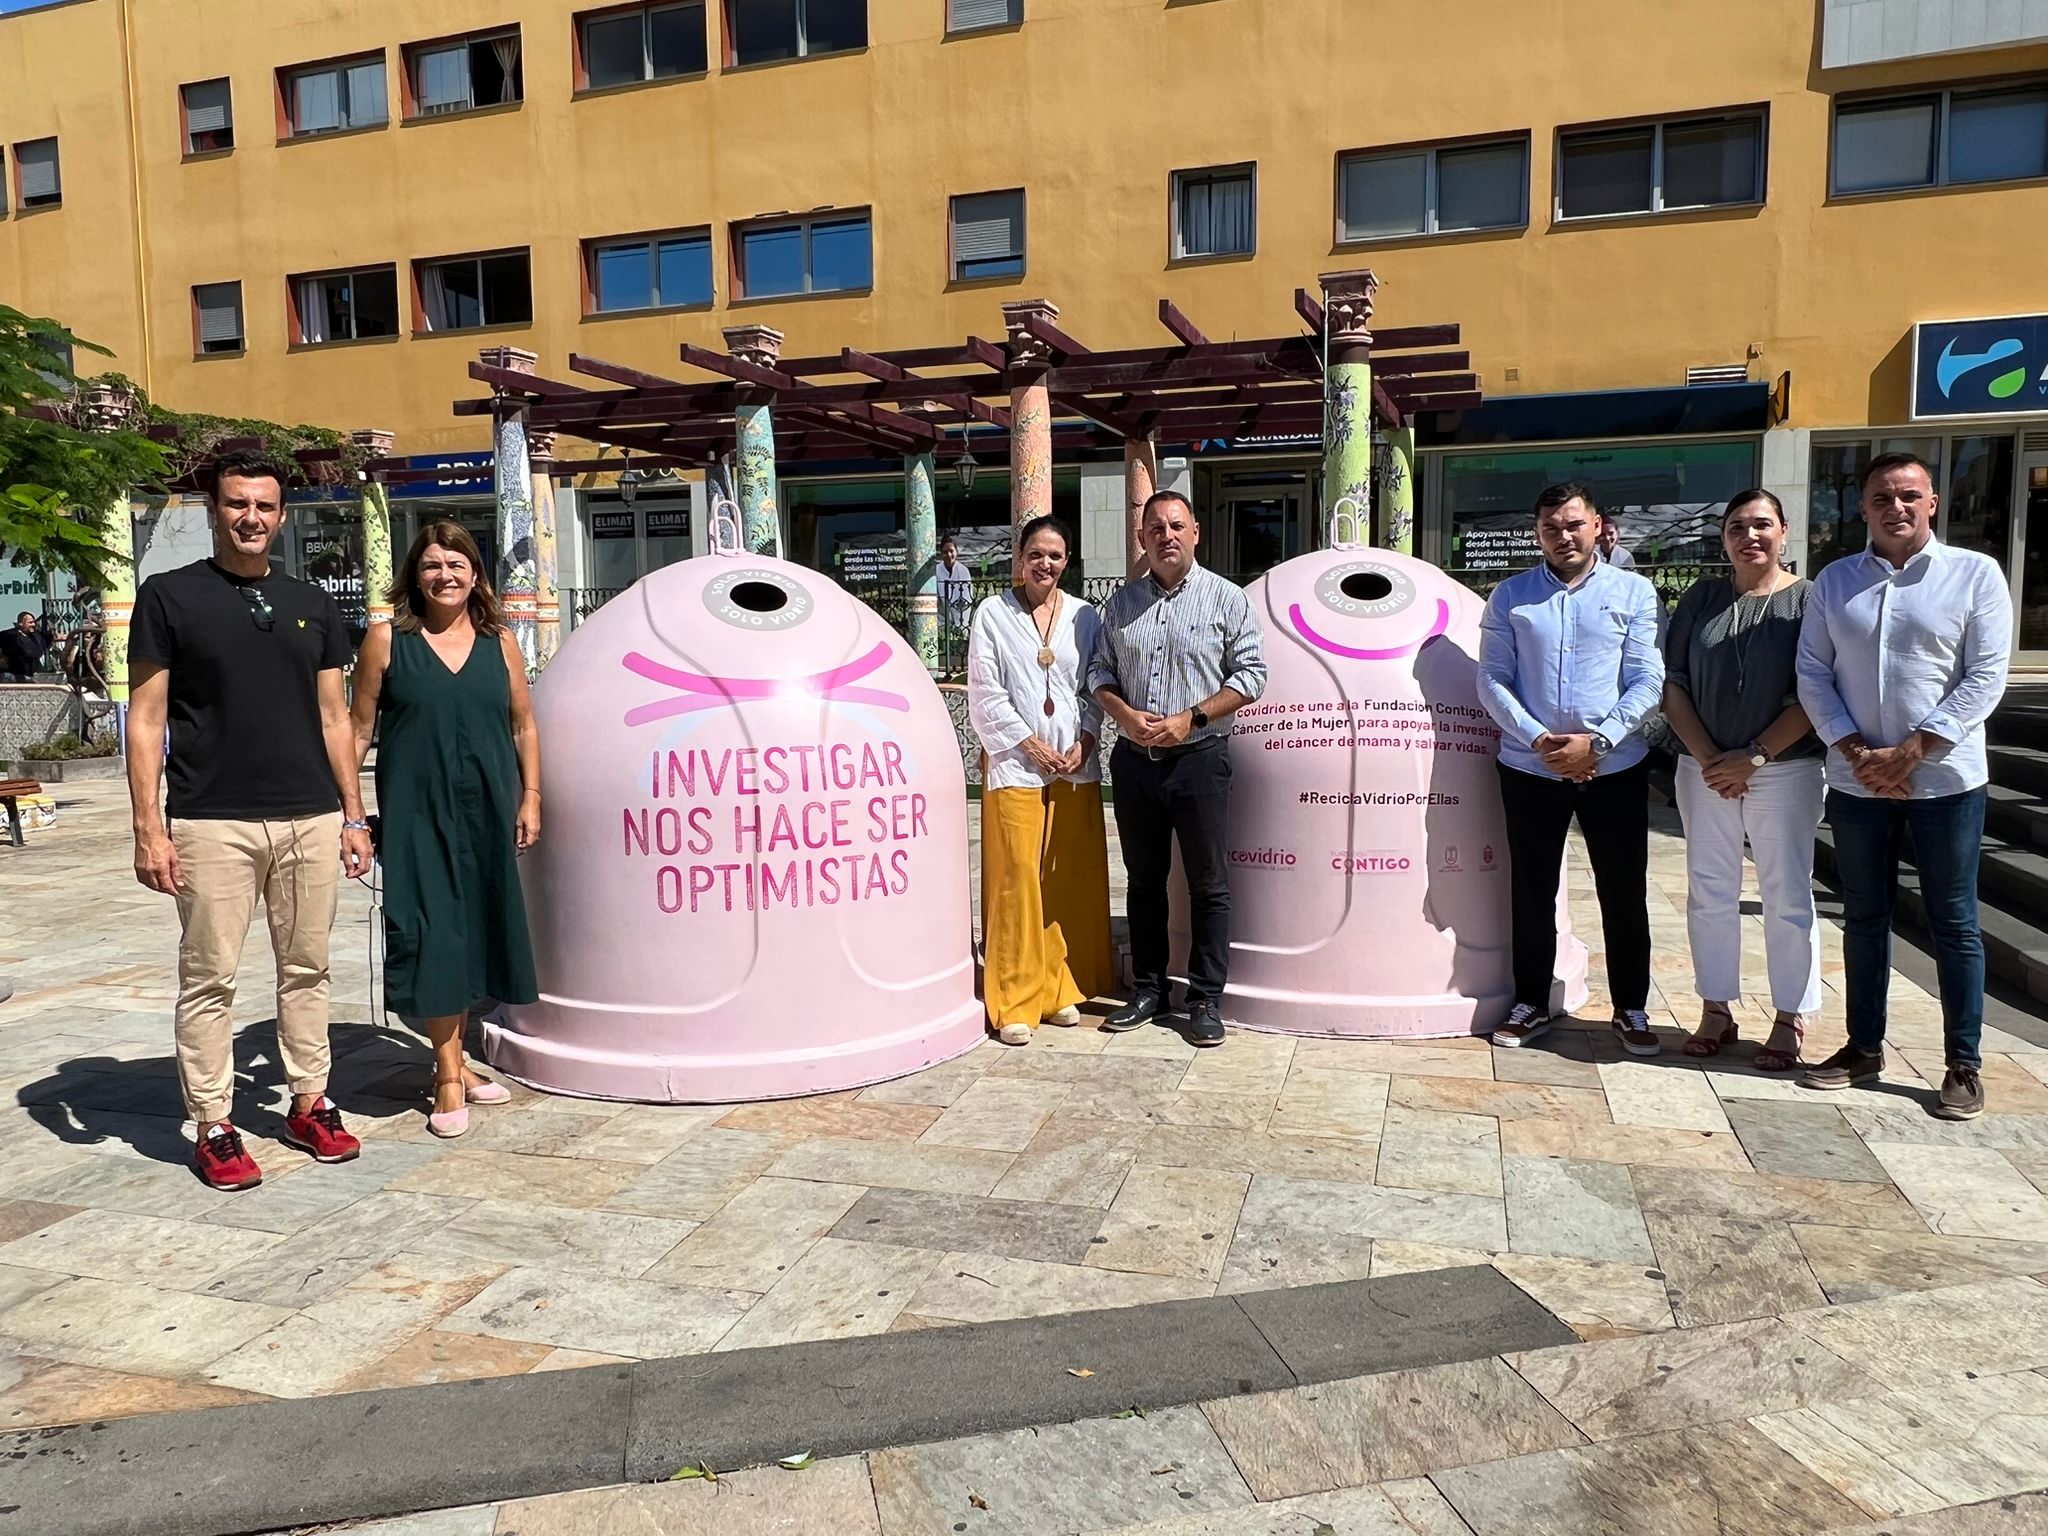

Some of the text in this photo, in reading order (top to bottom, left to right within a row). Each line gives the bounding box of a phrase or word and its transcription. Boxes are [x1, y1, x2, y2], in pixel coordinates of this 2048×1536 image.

[595, 516, 632, 527] ELIMAT
[648, 514, 688, 525] ELIMAT
[1465, 531, 1510, 539] Apoyamos
[1493, 539, 1504, 547] las
[1465, 549, 1509, 557] soluciones
[1473, 559, 1509, 568] digitales
[712, 571, 797, 594] SOLO VIDRIO
[1325, 564, 1406, 584] SOLO VIDRIO
[1324, 591, 1407, 613] SOLO VIDRIO
[720, 597, 806, 625] SOLO VIDRIO
[1236, 702, 1286, 718] covidrio
[1289, 704, 1304, 713] se
[1308, 702, 1333, 712] une
[1337, 702, 1345, 711] a
[1347, 700, 1359, 711] la
[1436, 702, 1484, 719] Contigo
[1232, 722, 1274, 736] Cáncer
[1277, 720, 1293, 731] de
[1297, 718, 1308, 730] la
[1312, 717, 1350, 731] Mujer
[1358, 719, 1389, 730] para
[1392, 720, 1435, 733] apoyar
[1440, 721, 1450, 732] la
[1265, 738, 1284, 750] del
[1287, 736, 1334, 749] cáncer
[1338, 735, 1355, 747] de
[1358, 737, 1401, 747] mama
[1404, 738, 1411, 751] y
[1415, 738, 1453, 751] salvar
[652, 741, 907, 798] INVESTIGAR
[1299, 791, 1460, 805] #ReciclaVidrioPorEllas
[623, 793, 928, 856] NOS HACE SER
[1227, 848, 1297, 865] covidrio
[1331, 857, 1411, 871] CONTIGO
[657, 849, 908, 913] OPTIMISTAS
